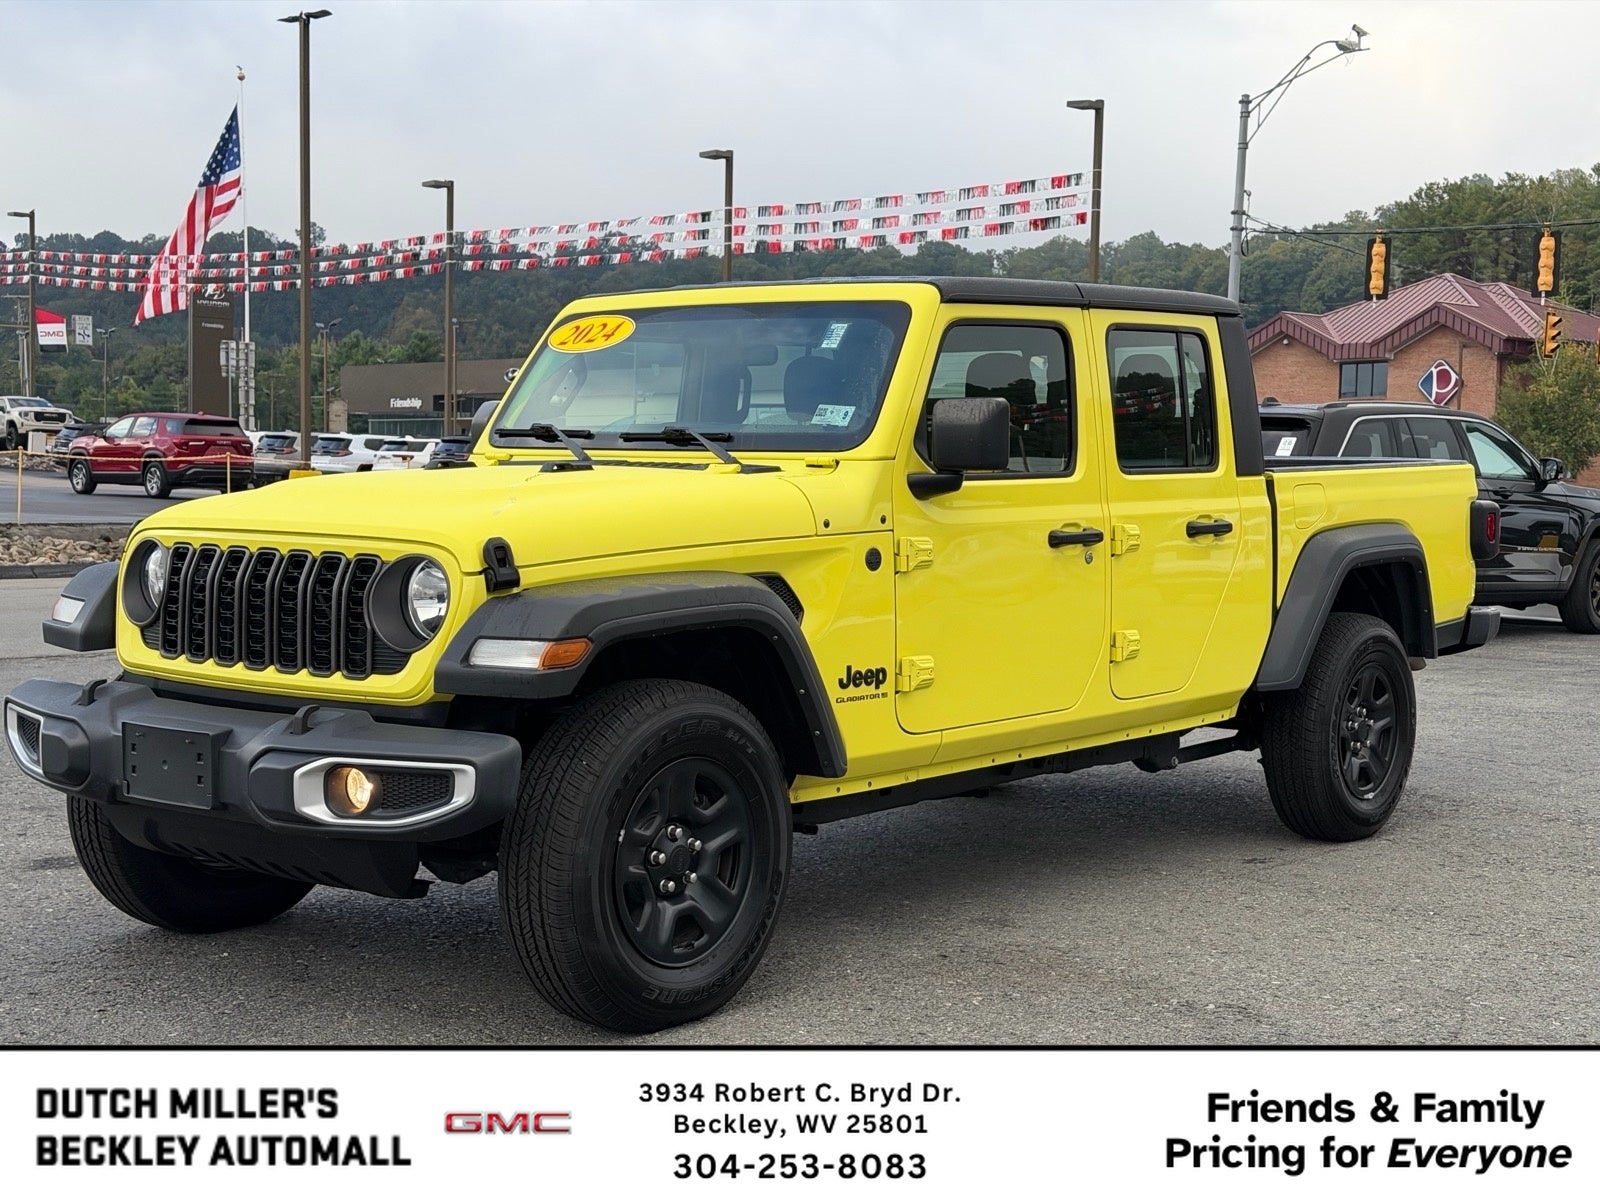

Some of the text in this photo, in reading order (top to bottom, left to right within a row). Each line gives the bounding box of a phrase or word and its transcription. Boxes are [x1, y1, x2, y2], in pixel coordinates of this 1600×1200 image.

[557, 321, 624, 346] 2024
[390, 397, 422, 410] Friendship
[838, 664, 887, 690] Jeep
[835, 693, 881, 704] GLADIATOR
